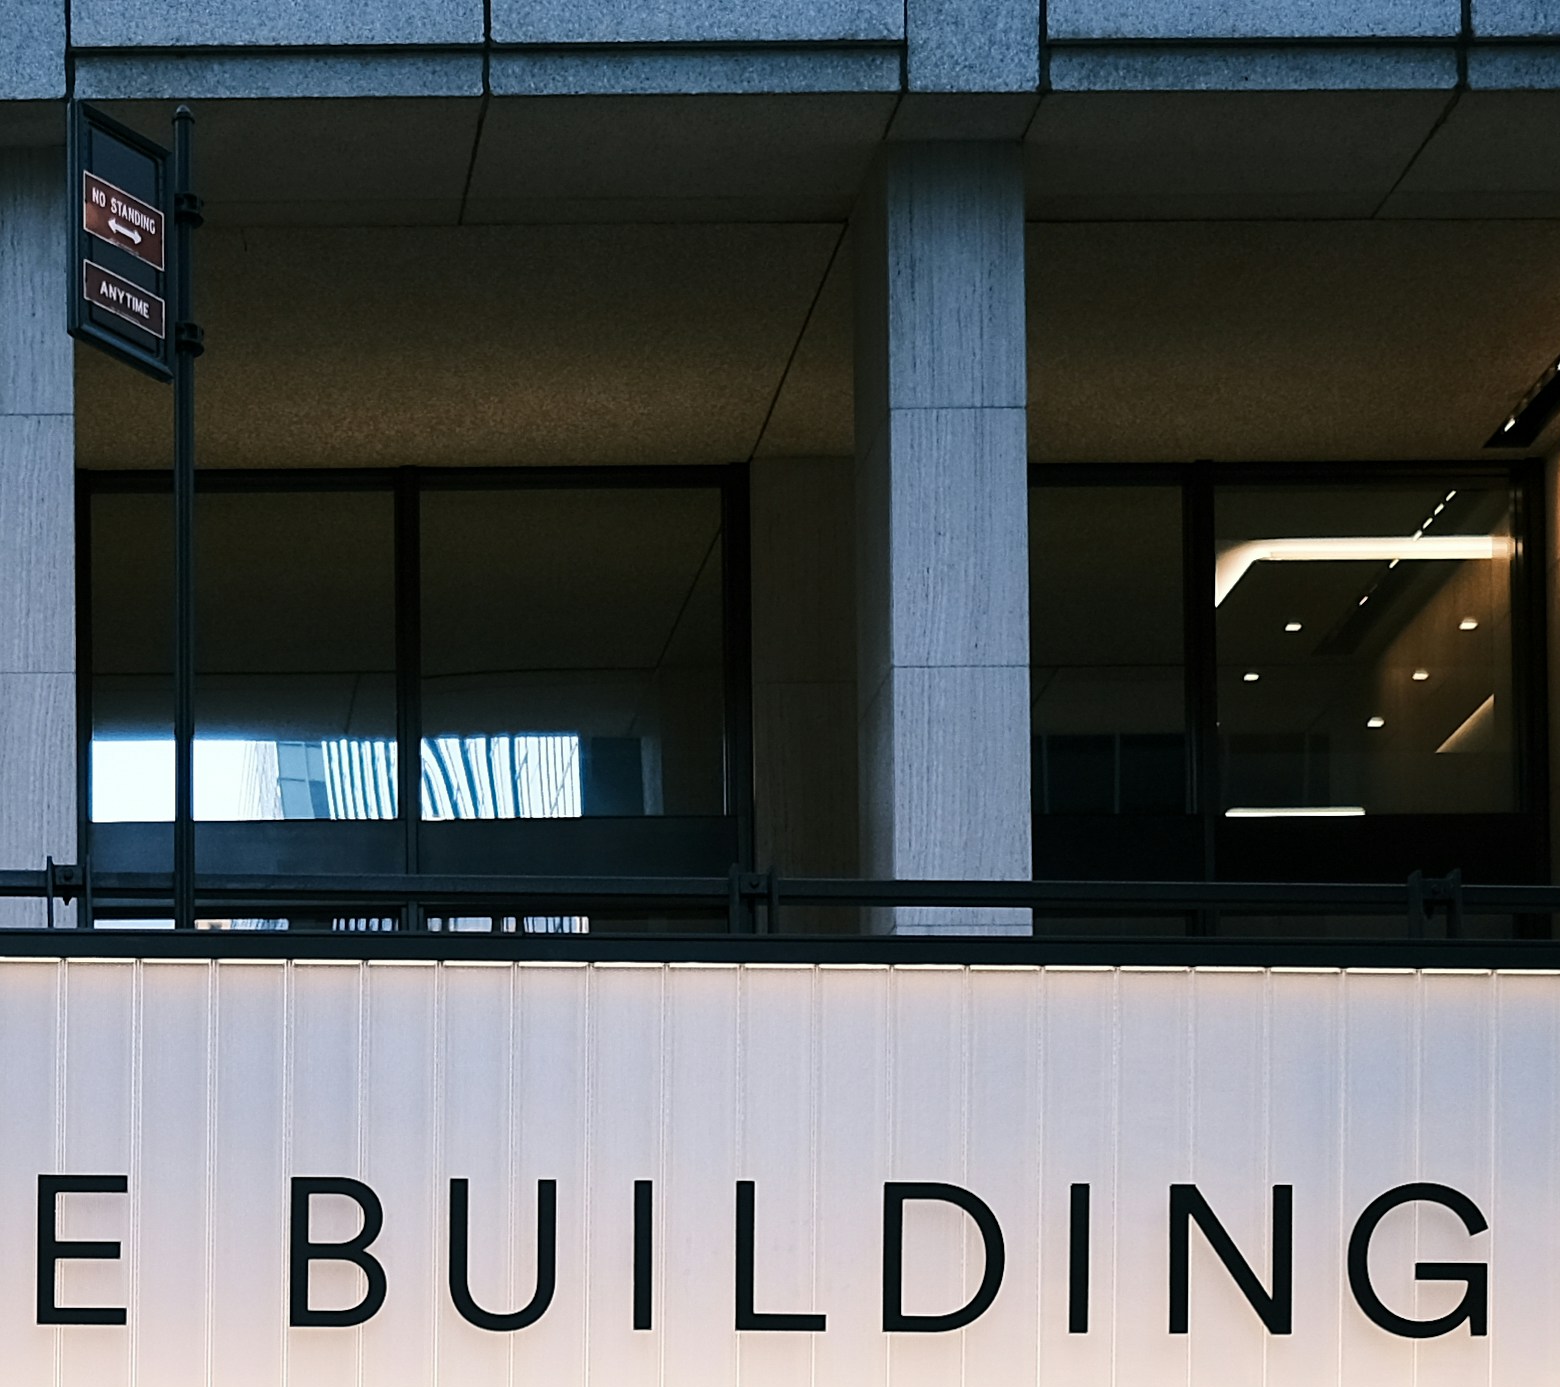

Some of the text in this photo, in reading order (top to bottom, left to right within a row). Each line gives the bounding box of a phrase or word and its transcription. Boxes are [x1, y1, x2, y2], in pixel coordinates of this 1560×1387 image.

[91, 187, 155, 234] NO STANDING
[99, 281, 150, 319] ANYTIME
[290, 1177, 1488, 1338] BUILDING
